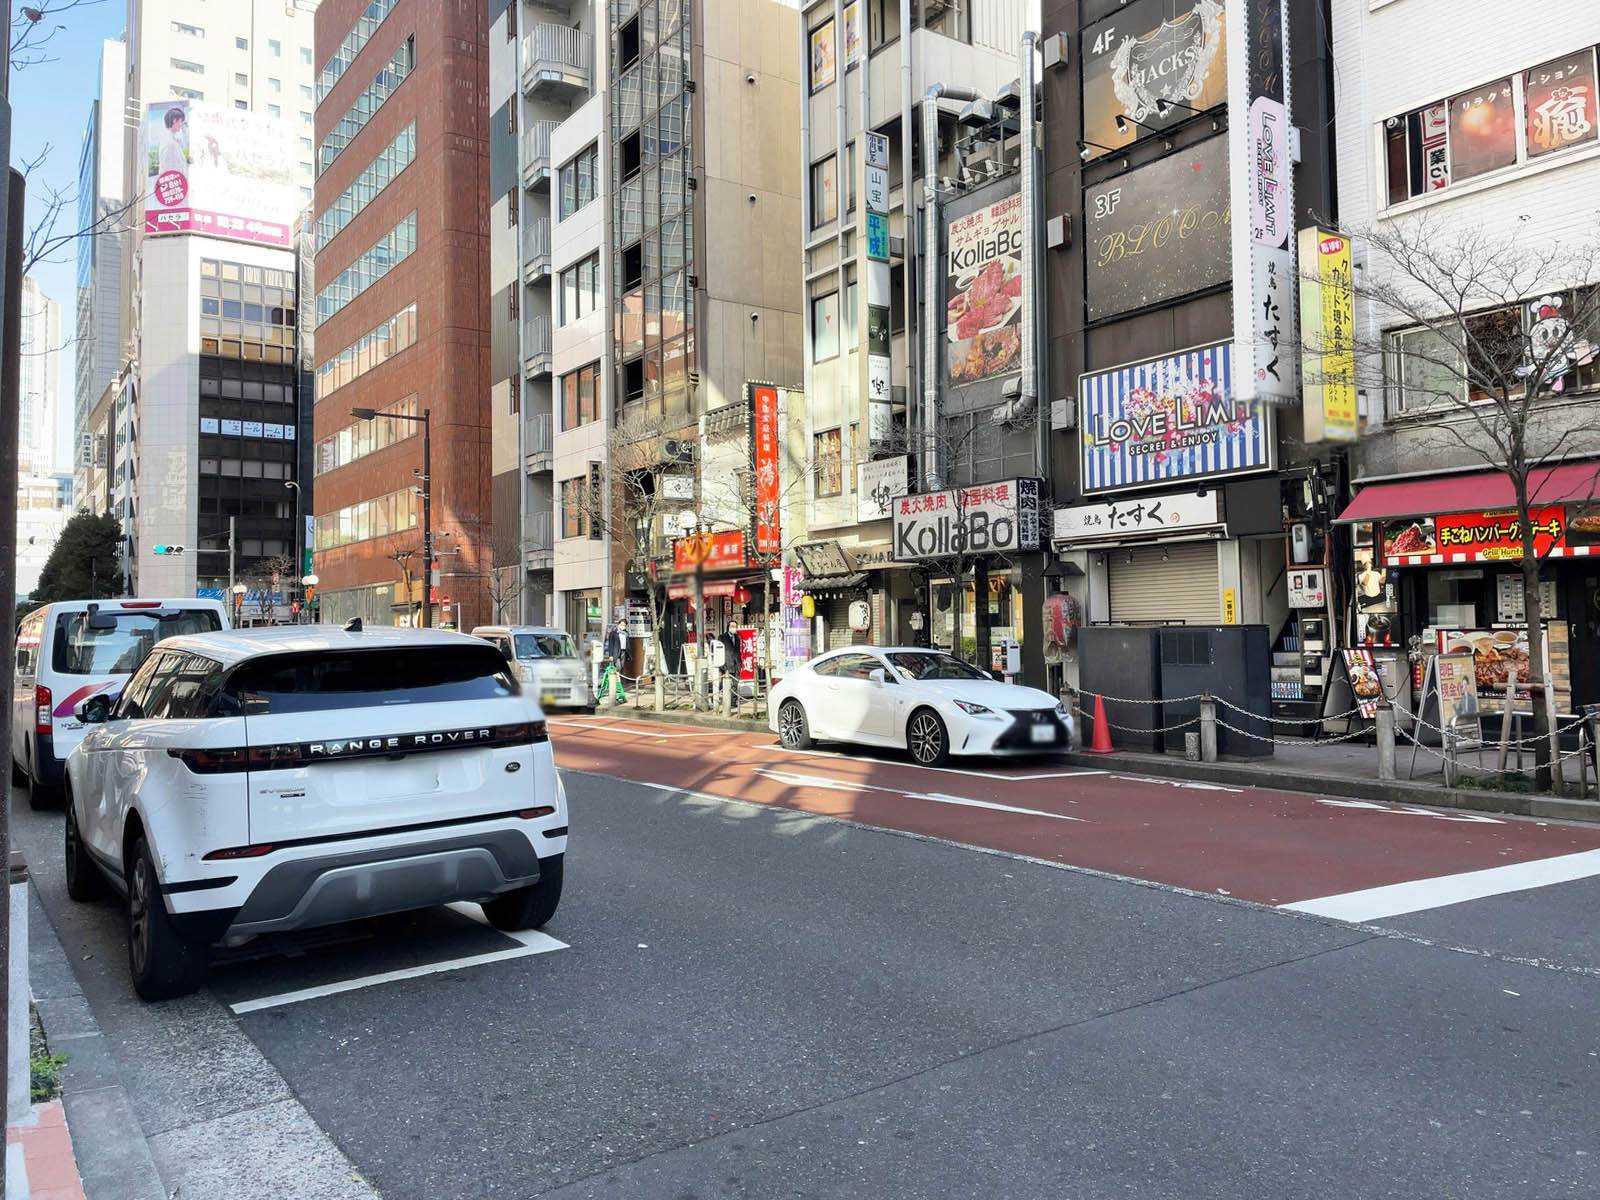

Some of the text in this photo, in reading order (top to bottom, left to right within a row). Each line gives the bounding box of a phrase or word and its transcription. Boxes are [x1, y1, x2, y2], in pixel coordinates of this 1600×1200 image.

[1092, 28, 1116, 54] 4F
[1262, 112, 1278, 237] LOVE LIMIT
[1095, 188, 1122, 219] 3F
[1263, 294, 1281, 383] たすく
[1094, 412, 1168, 447] LOVE
[1129, 441, 1166, 456] SECRET
[1182, 430, 1218, 446] ENJOY
[1020, 479, 1037, 509] 焼肉
[1108, 501, 1164, 530] たすく
[898, 510, 1013, 557] KollaBo
[1440, 518, 1561, 546] 手ごねハンバーグテーキ
[309, 728, 491, 756] RANGE ROVER
